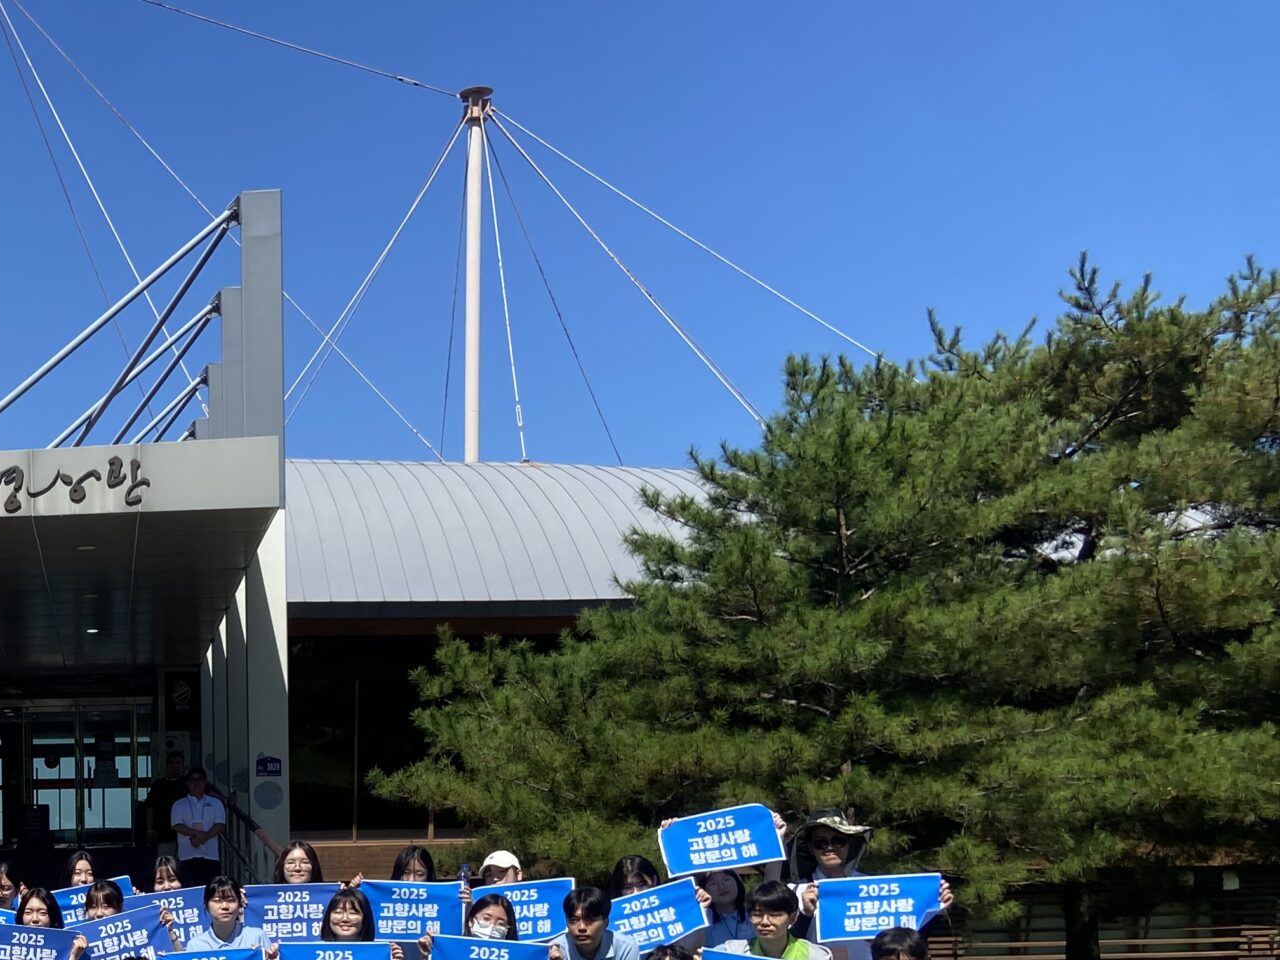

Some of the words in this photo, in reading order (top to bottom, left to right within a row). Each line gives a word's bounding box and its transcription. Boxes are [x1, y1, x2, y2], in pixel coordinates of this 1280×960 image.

[696, 816, 736, 834] 2025
[688, 829, 751, 851] 고향사랑
[690, 846, 738, 866] 방문의
[741, 843, 758, 858] 해
[277, 891, 310, 902] 2025
[392, 888, 427, 899] 2025
[859, 883, 900, 897] 2025
[264, 904, 324, 920] 고향사랑
[380, 903, 439, 918] 고향사랑
[621, 895, 660, 914] 2025
[846, 898, 915, 916] 고향사랑
[173, 908, 199, 924] 사랑
[614, 907, 676, 933] 고향사랑
[844, 915, 895, 932] 방문의
[899, 914, 916, 929] 해
[98, 919, 132, 938] 2025
[263, 923, 307, 937] 방문의
[378, 919, 421, 934] 방문의
[537, 919, 551, 933] 해
[630, 927, 665, 945] 문의
[667, 922, 684, 937] 해
[11, 932, 45, 946] 2025
[88, 929, 149, 957] 고향사랑
[470, 946, 509, 960] 2025
